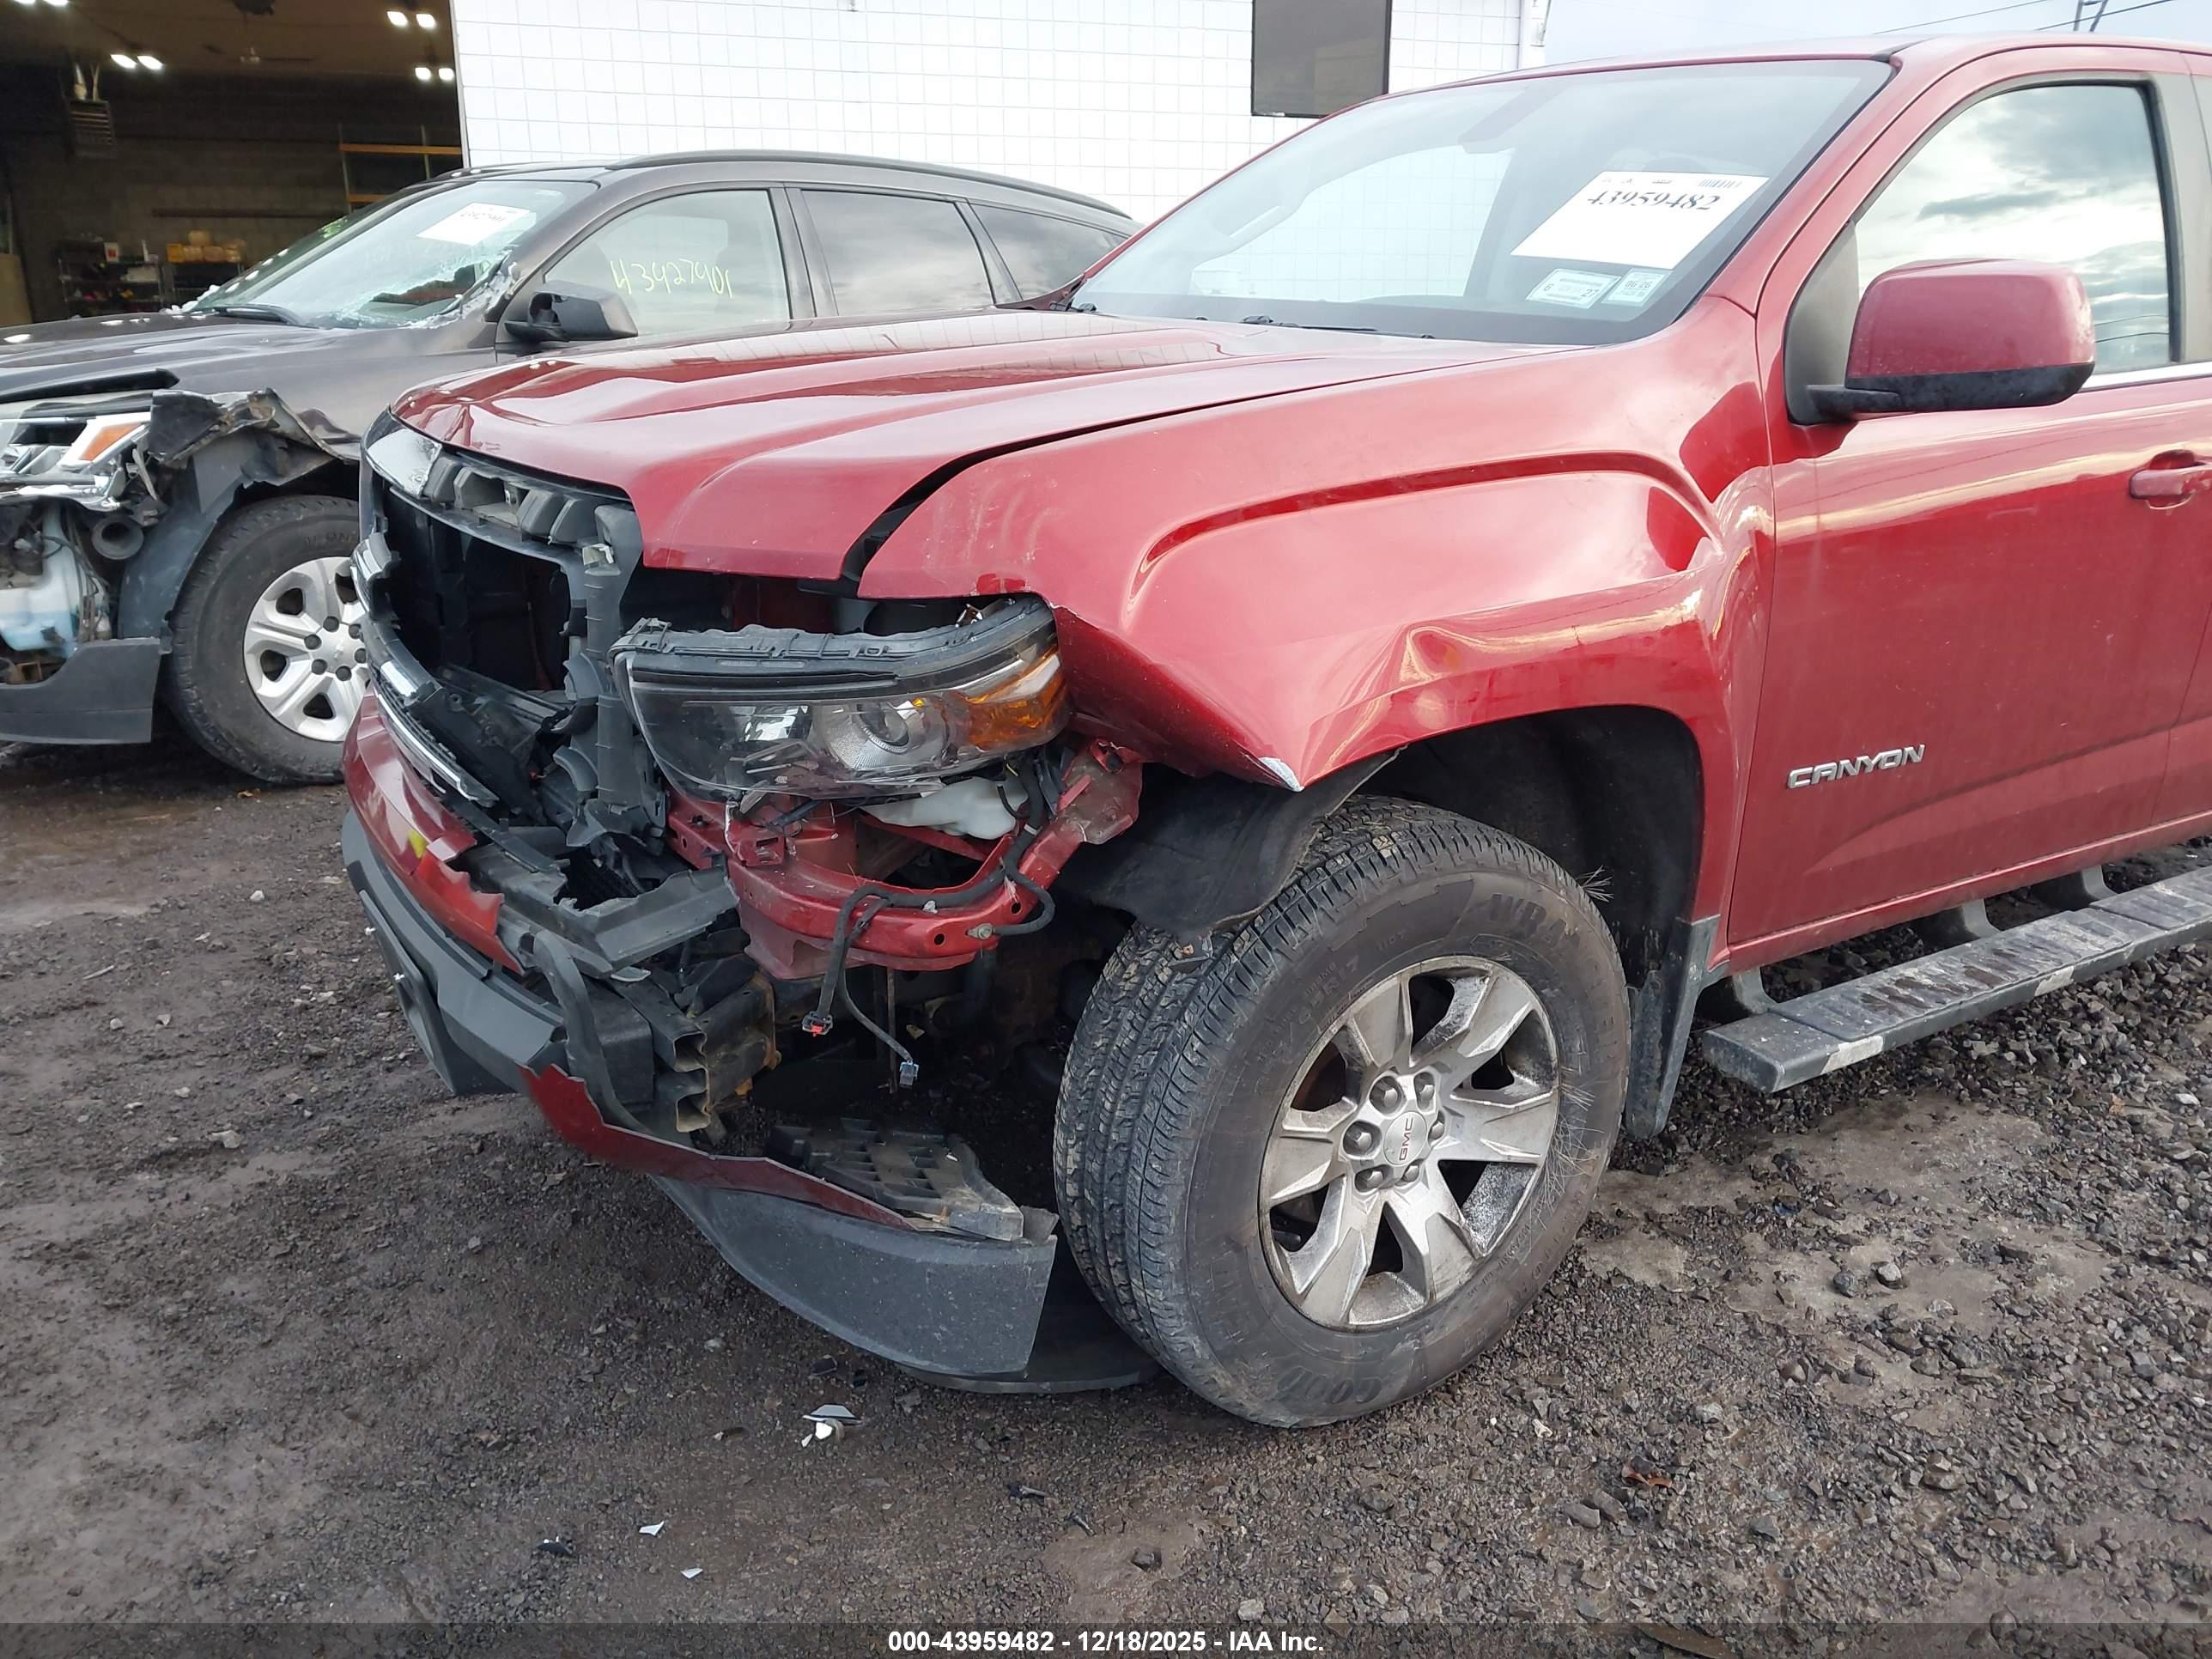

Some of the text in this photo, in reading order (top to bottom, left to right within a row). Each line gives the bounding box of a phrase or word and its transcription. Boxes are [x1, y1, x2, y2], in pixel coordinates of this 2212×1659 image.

[1587, 190, 1721, 210] 43959482
[1787, 744, 1926, 789] CANYON
[1398, 1117, 1414, 1161] GMC
